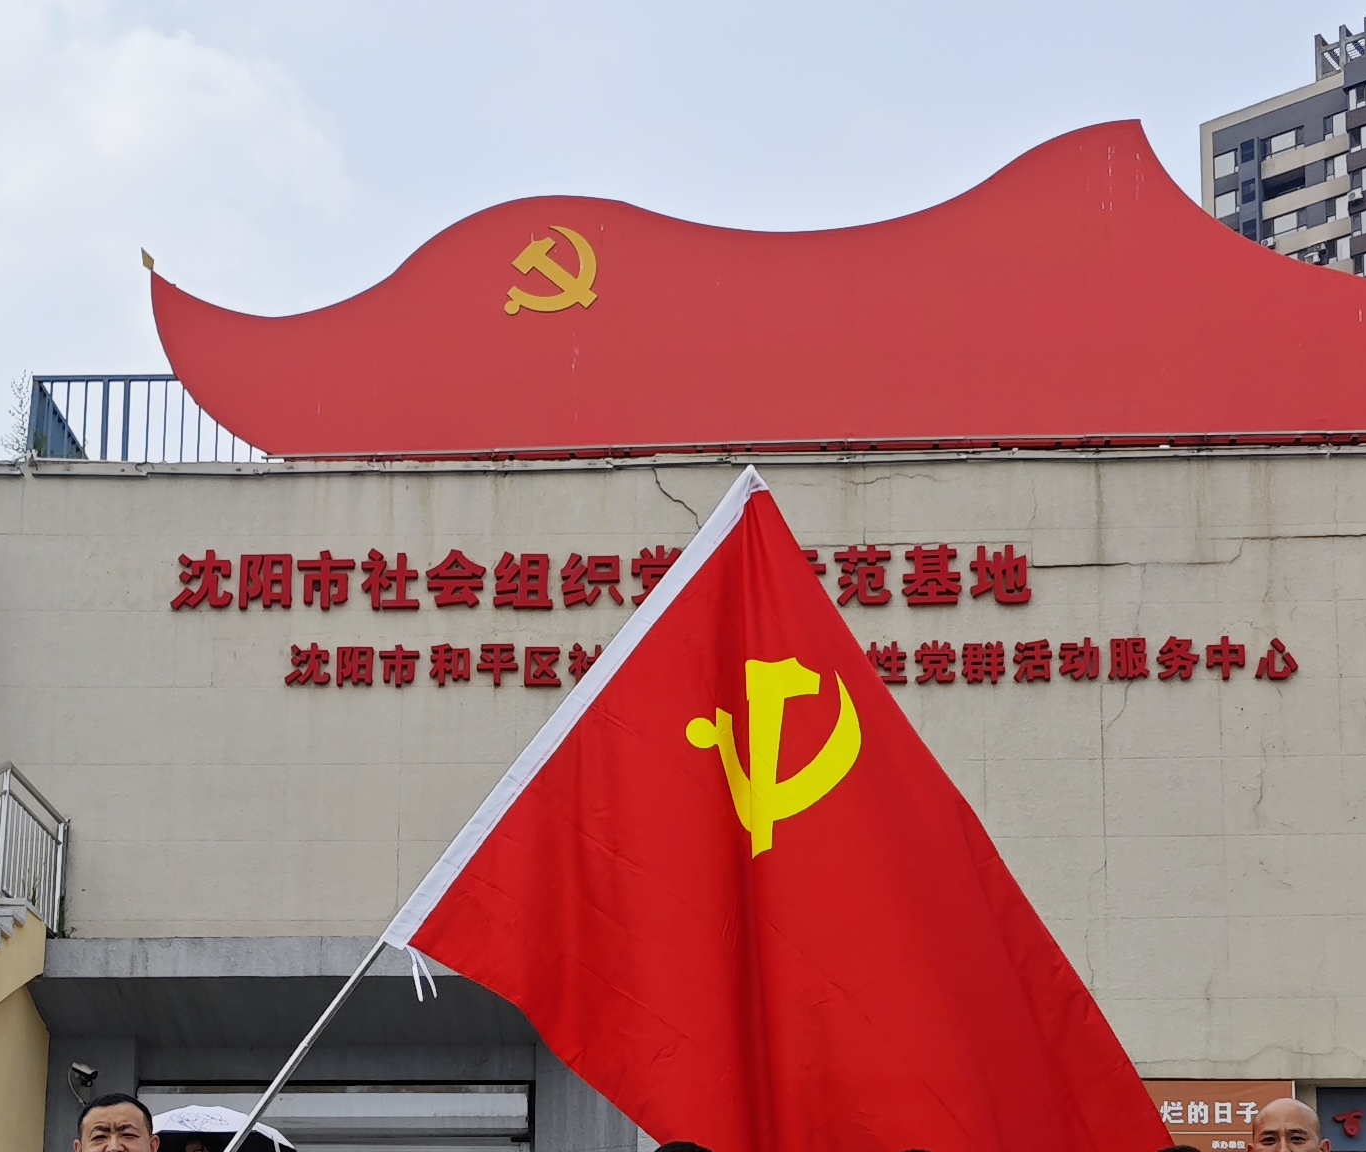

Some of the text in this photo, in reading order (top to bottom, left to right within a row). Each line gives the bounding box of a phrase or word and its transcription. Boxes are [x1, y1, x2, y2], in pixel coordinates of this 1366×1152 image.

[171, 544, 1033, 611] 沈阳市社会组织党范基地
[284, 635, 1299, 689] 沈阳市和平区社性党群活动服务中心
[1160, 1101, 1259, 1125] 烂的日子
